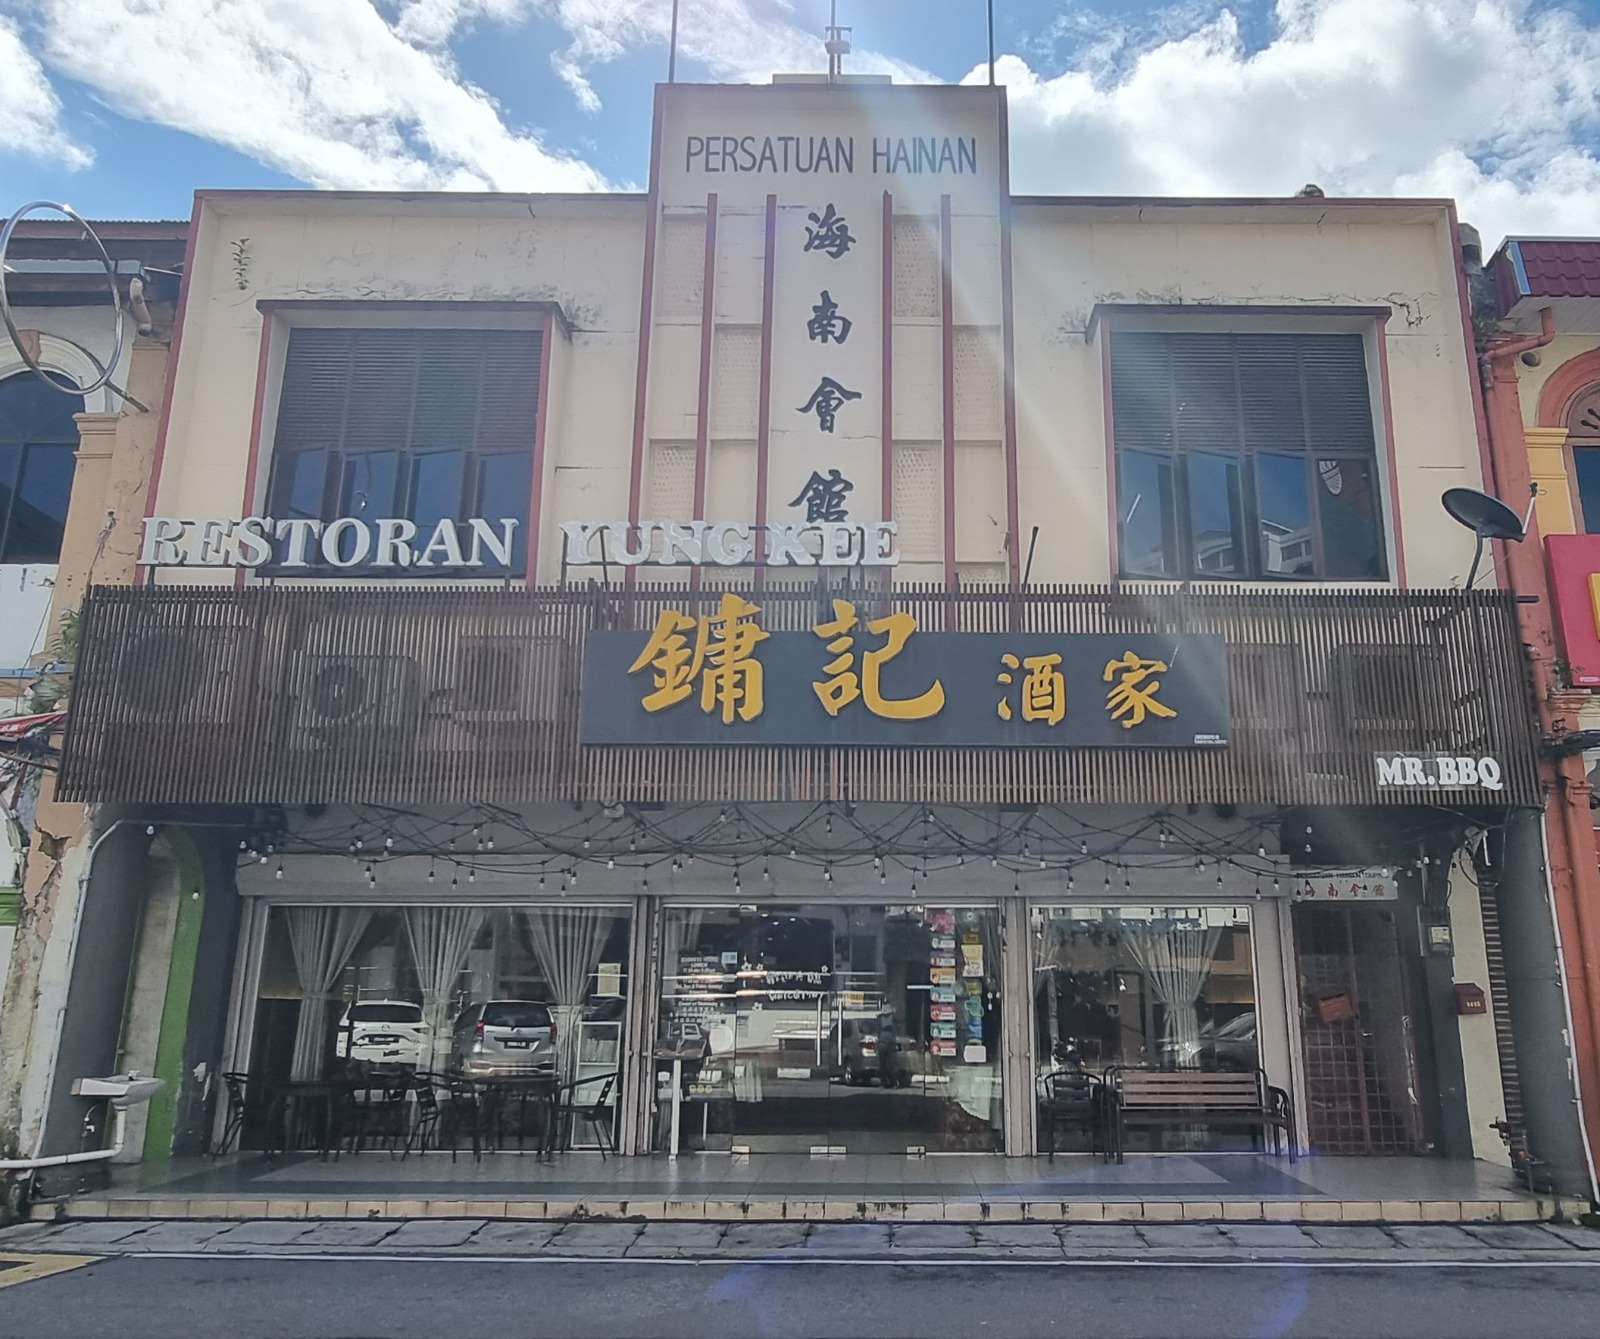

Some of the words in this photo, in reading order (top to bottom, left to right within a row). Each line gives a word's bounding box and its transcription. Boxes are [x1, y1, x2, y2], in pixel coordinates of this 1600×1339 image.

[686, 136, 854, 174] PERSATUAN
[872, 137, 977, 174] HAINAN
[788, 203, 862, 523] 海南會館
[136, 516, 519, 568] RESTORAN
[560, 519, 754, 566] YUNG
[766, 520, 901, 567] KEE
[1376, 756, 1503, 791] MR.BBQ
